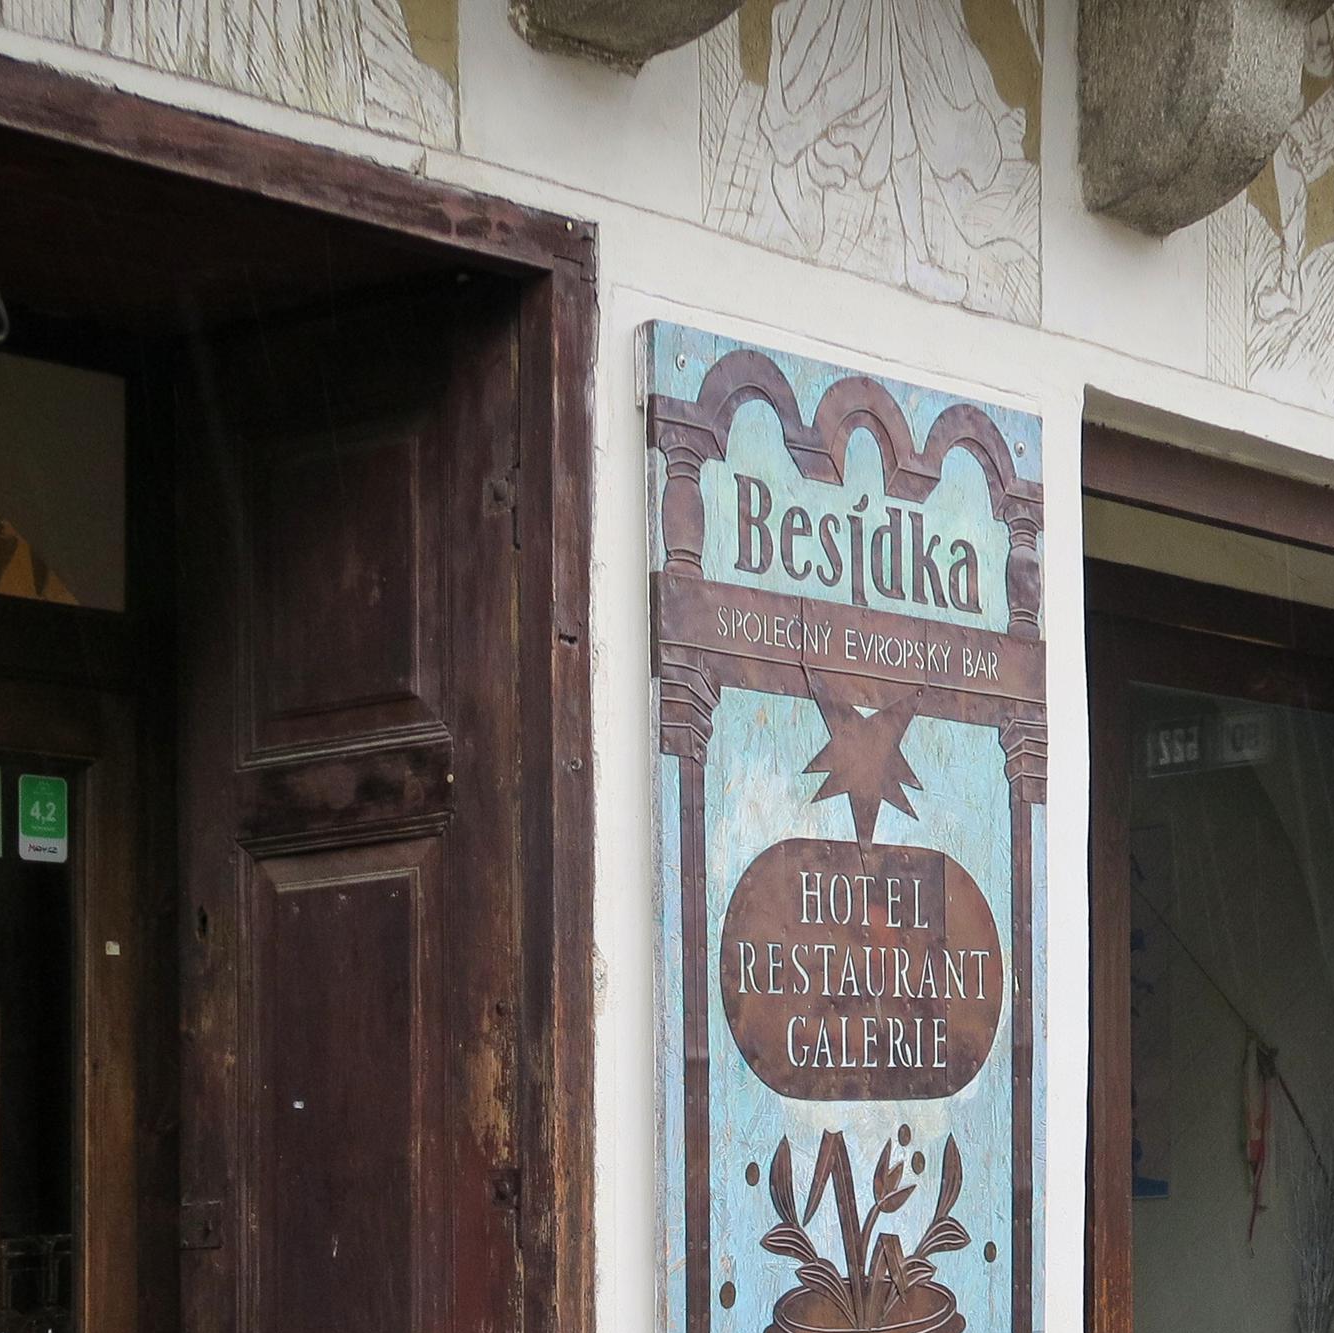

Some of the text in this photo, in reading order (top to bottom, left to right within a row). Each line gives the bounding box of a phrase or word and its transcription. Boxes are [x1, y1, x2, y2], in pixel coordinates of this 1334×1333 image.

[733, 472, 983, 615] Besídka
[717, 606, 1000, 681] SPOLEČNÝ EVROPSKÝ BAR
[799, 871, 929, 929] HOTEL
[737, 941, 991, 1000] RESTAURANT
[786, 1015, 949, 1068] GALERIE
